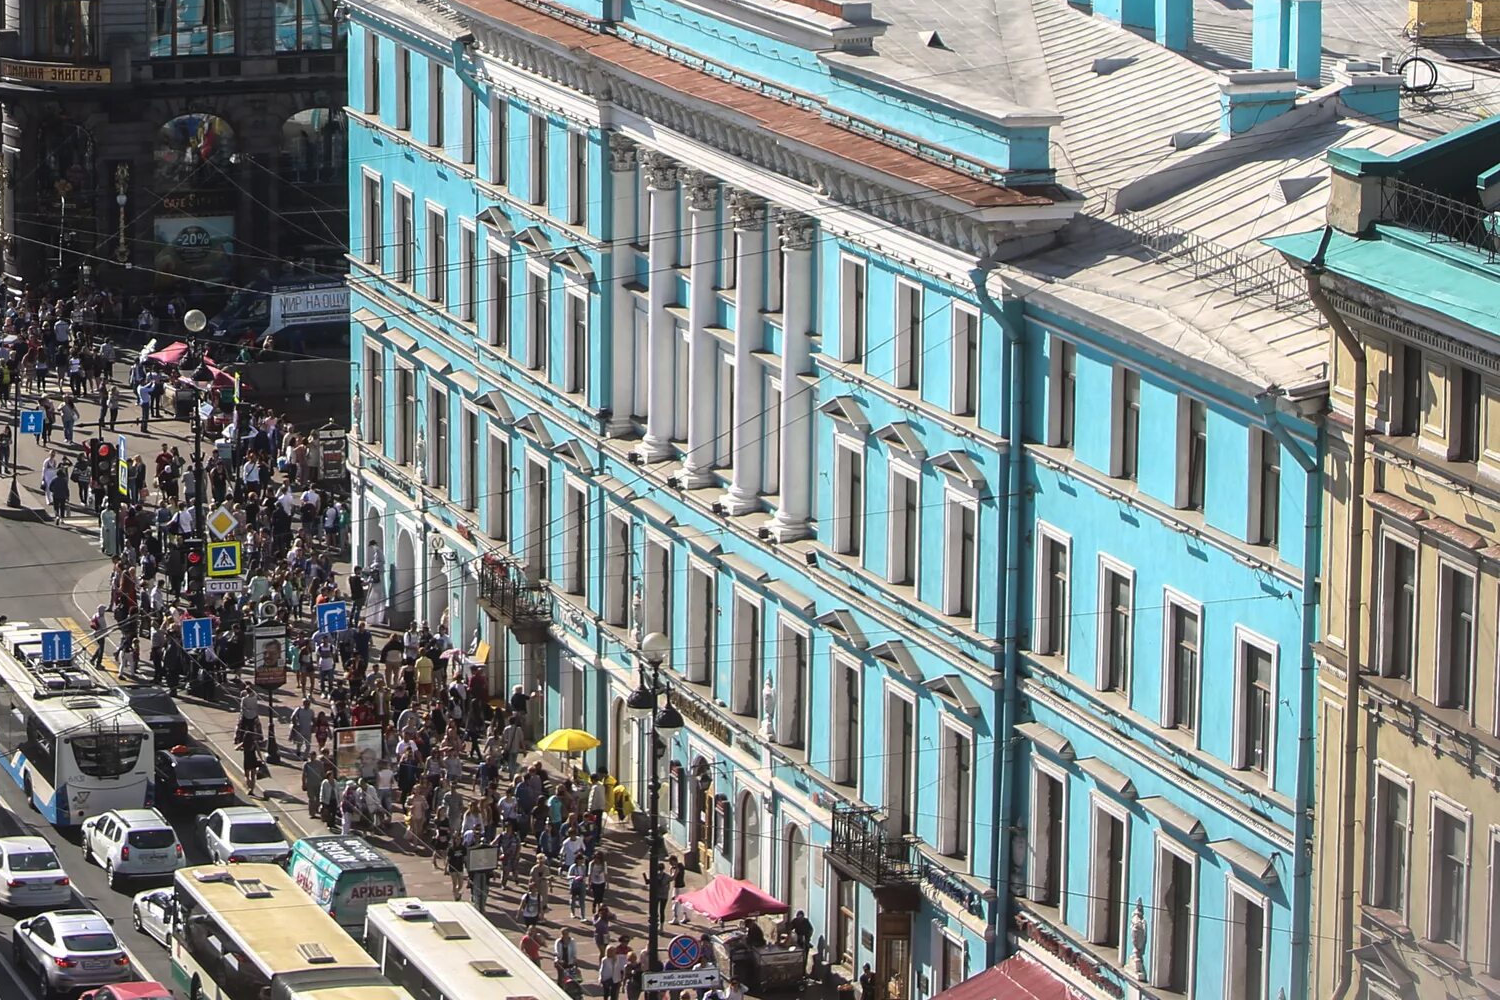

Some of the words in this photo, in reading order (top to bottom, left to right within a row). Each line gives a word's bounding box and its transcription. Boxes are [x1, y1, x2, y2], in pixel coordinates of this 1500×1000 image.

[51, 68, 103, 81] ЗИНГЕРЪ
[178, 233, 210, 246] -20%
[280, 296, 302, 312] МИР
[305, 294, 321, 309] НА
[210, 582, 238, 590] СТОП
[350, 885, 394, 899] АРХЫЗ
